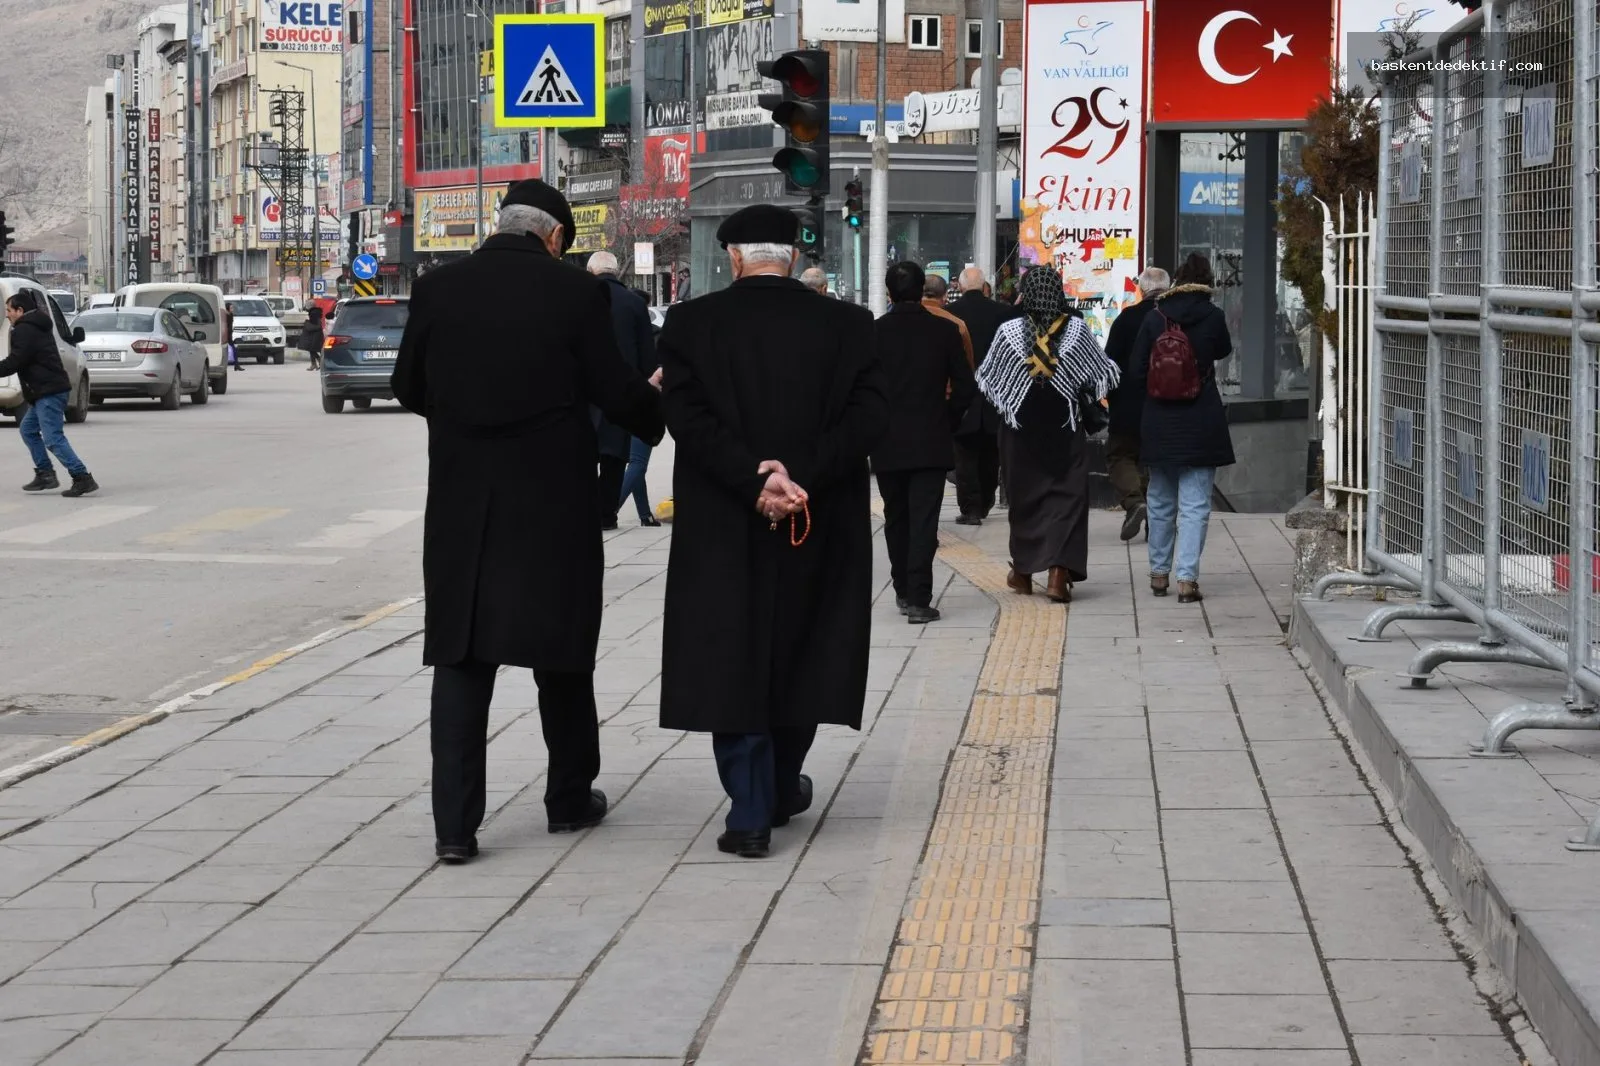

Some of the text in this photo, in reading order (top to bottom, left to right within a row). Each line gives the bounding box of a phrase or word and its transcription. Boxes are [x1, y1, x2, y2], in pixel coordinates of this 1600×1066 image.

[280, 2, 342, 26] KELE
[265, 26, 332, 43] SÜRÜCÜ
[297, 43, 309, 51] 210
[310, 43, 318, 51] 18
[1043, 65, 1129, 78] VAN VALİLİĞİ
[1040, 87, 1130, 165] 29
[128, 121, 138, 170] HOTEL
[150, 148, 159, 201] APART
[1035, 174, 1132, 211] Ekim
[128, 178, 138, 227] ROYAL
[464, 191, 489, 206] SARYI
[150, 208, 159, 262] HOTEL
